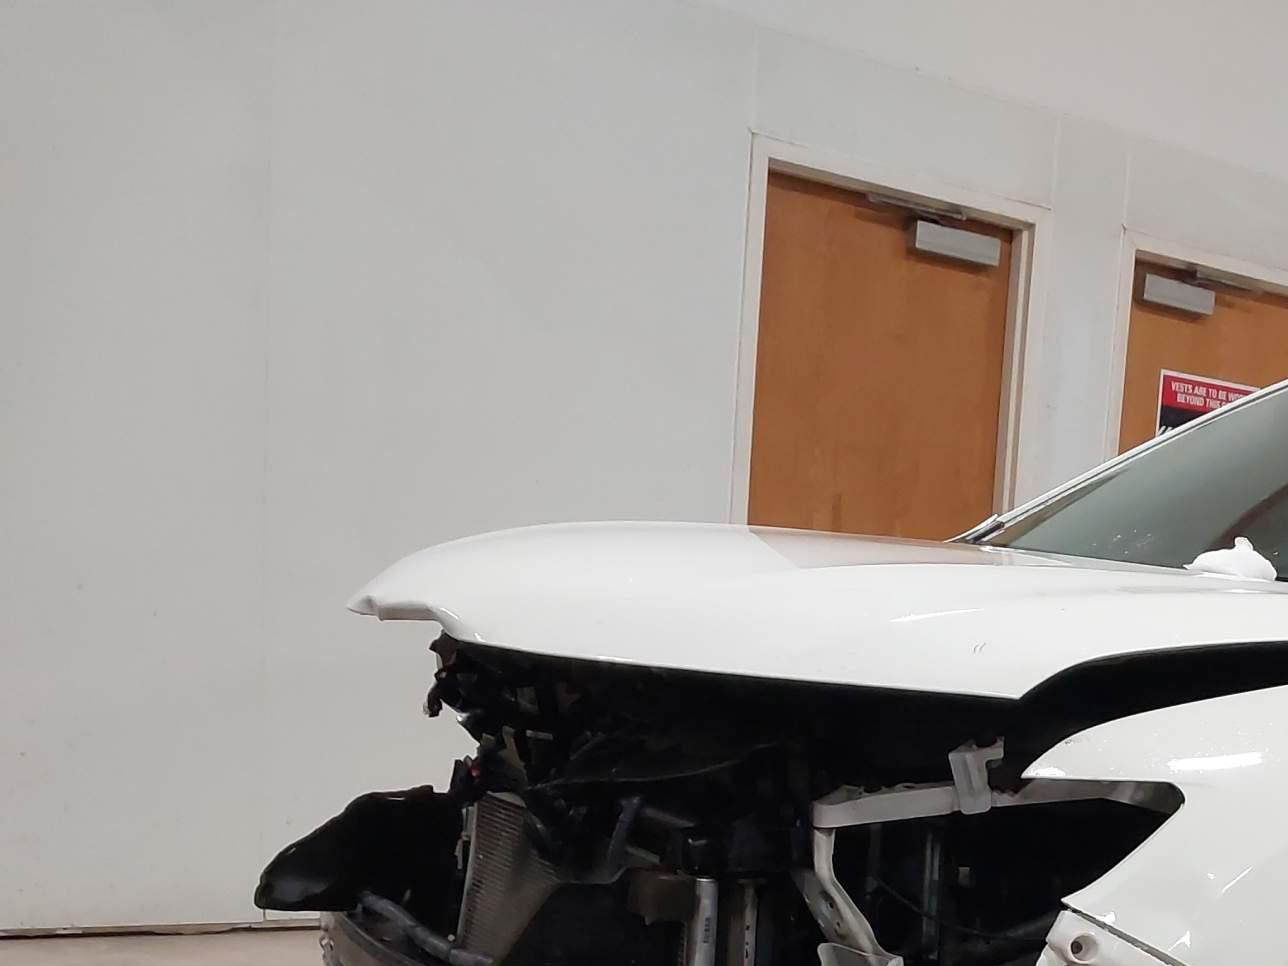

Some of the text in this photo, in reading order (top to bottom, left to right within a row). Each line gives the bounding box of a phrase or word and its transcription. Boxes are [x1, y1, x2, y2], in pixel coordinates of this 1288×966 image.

[1171, 381, 1192, 393] VESTS
[1194, 386, 1206, 396] ARE
[1208, 388, 1217, 399] TO
[1218, 390, 1227, 401] BE
[1176, 393, 1204, 406] BEYOND
[1206, 398, 1221, 409] THIS
